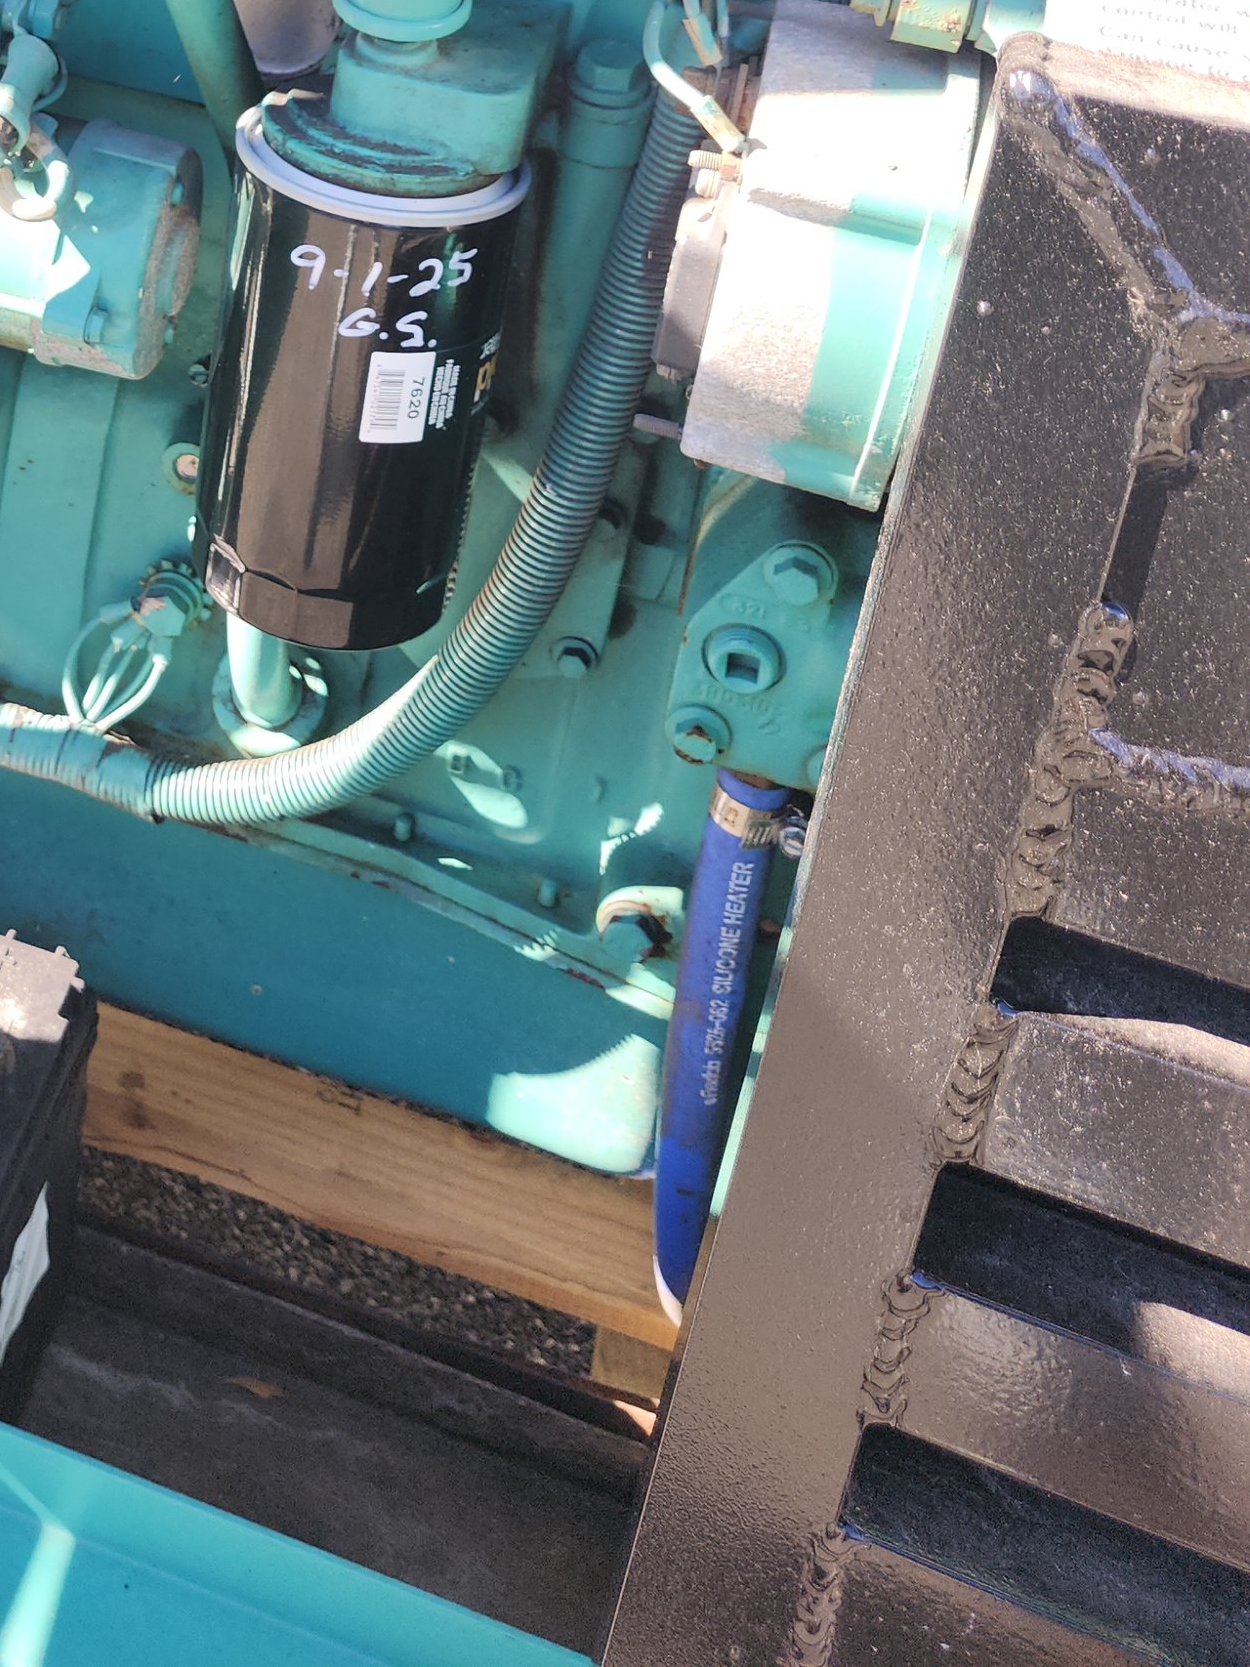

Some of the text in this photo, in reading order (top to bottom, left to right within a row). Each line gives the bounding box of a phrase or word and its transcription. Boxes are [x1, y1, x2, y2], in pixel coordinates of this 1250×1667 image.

[290, 243, 479, 298] 9-1-25
[406, 376, 426, 420] 7620
[723, 861, 756, 927] HEATER
[711, 926, 742, 995] SILICONE
